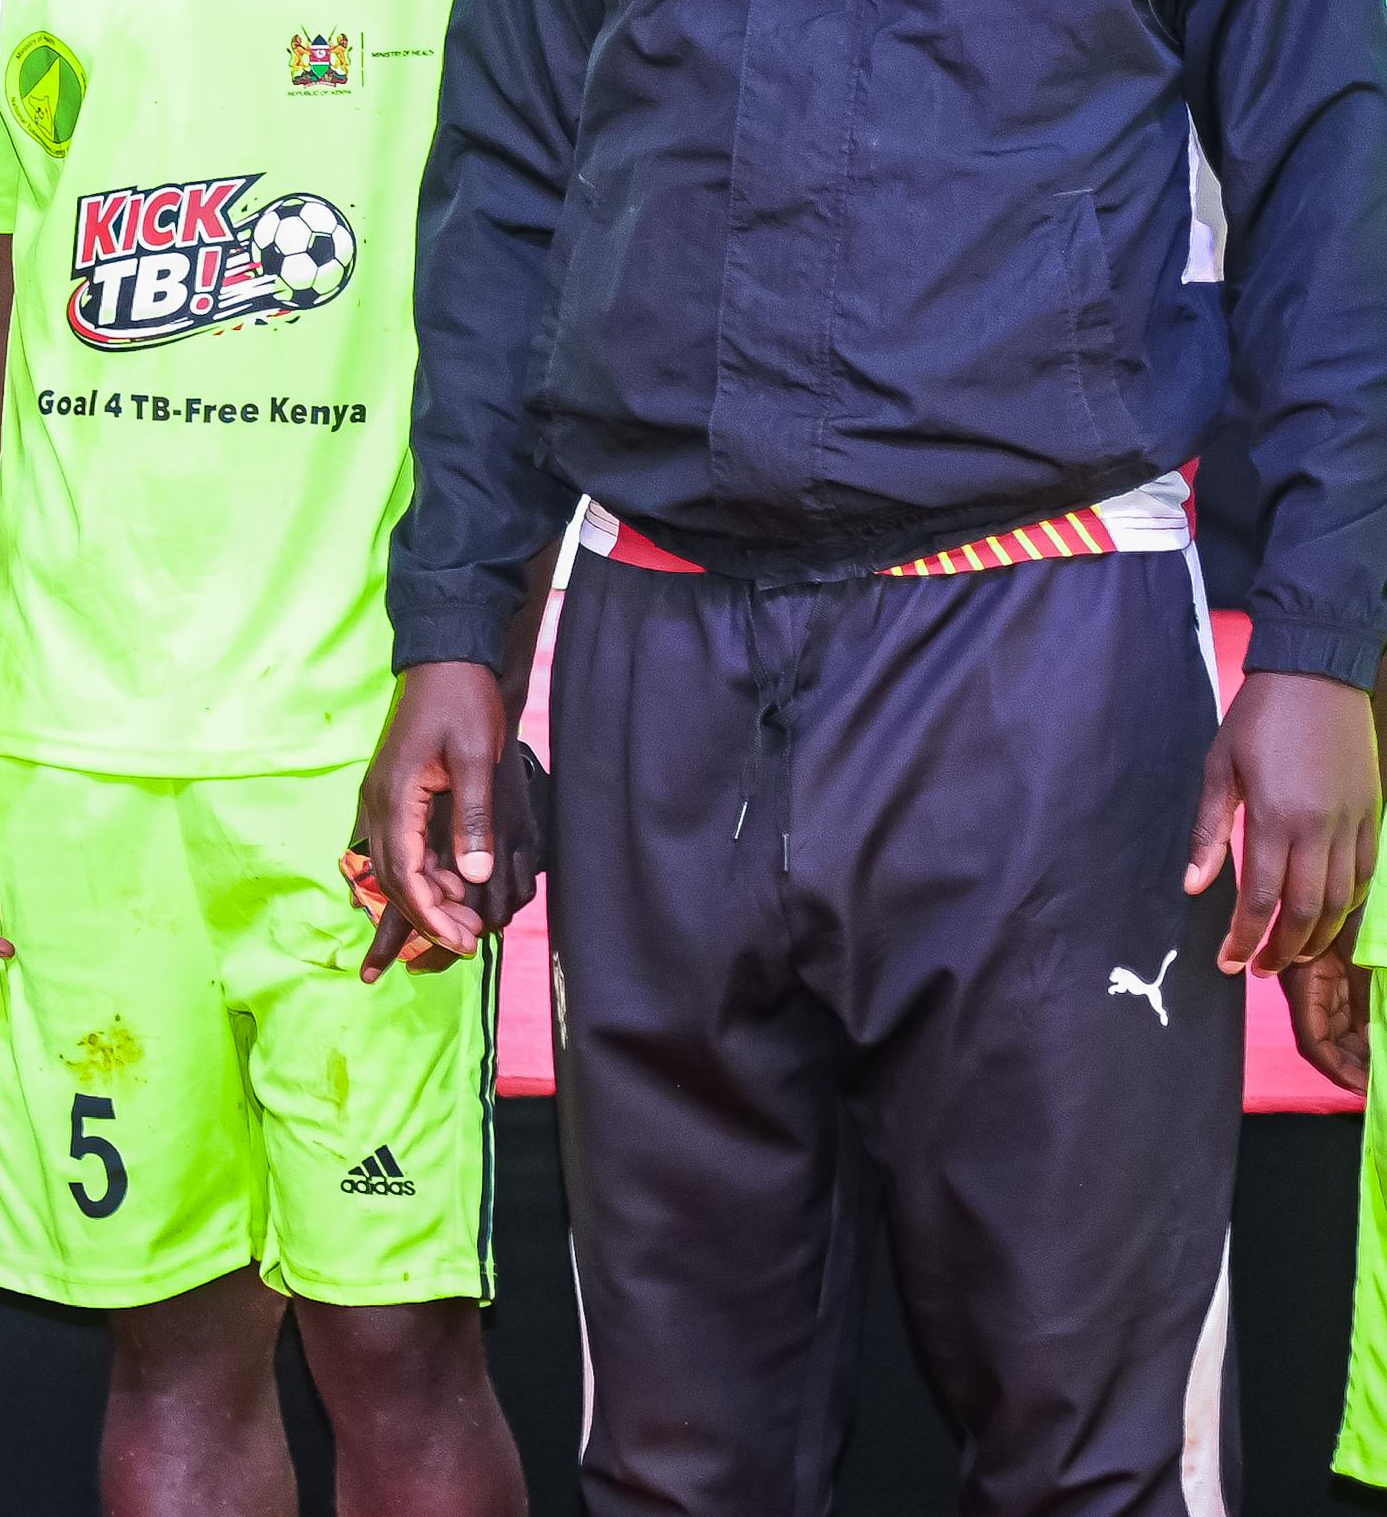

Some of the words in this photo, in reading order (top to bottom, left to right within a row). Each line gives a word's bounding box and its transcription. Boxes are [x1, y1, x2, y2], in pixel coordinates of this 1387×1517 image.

[75, 178, 247, 270] KICK
[93, 246, 222, 326] TB!
[38, 389, 98, 417] Goal
[104, 392, 122, 418] 4
[131, 394, 259, 424] TB-Free
[269, 396, 368, 433] Kenya
[68, 1092, 129, 1218] 5
[340, 1174, 416, 1197] adidas
